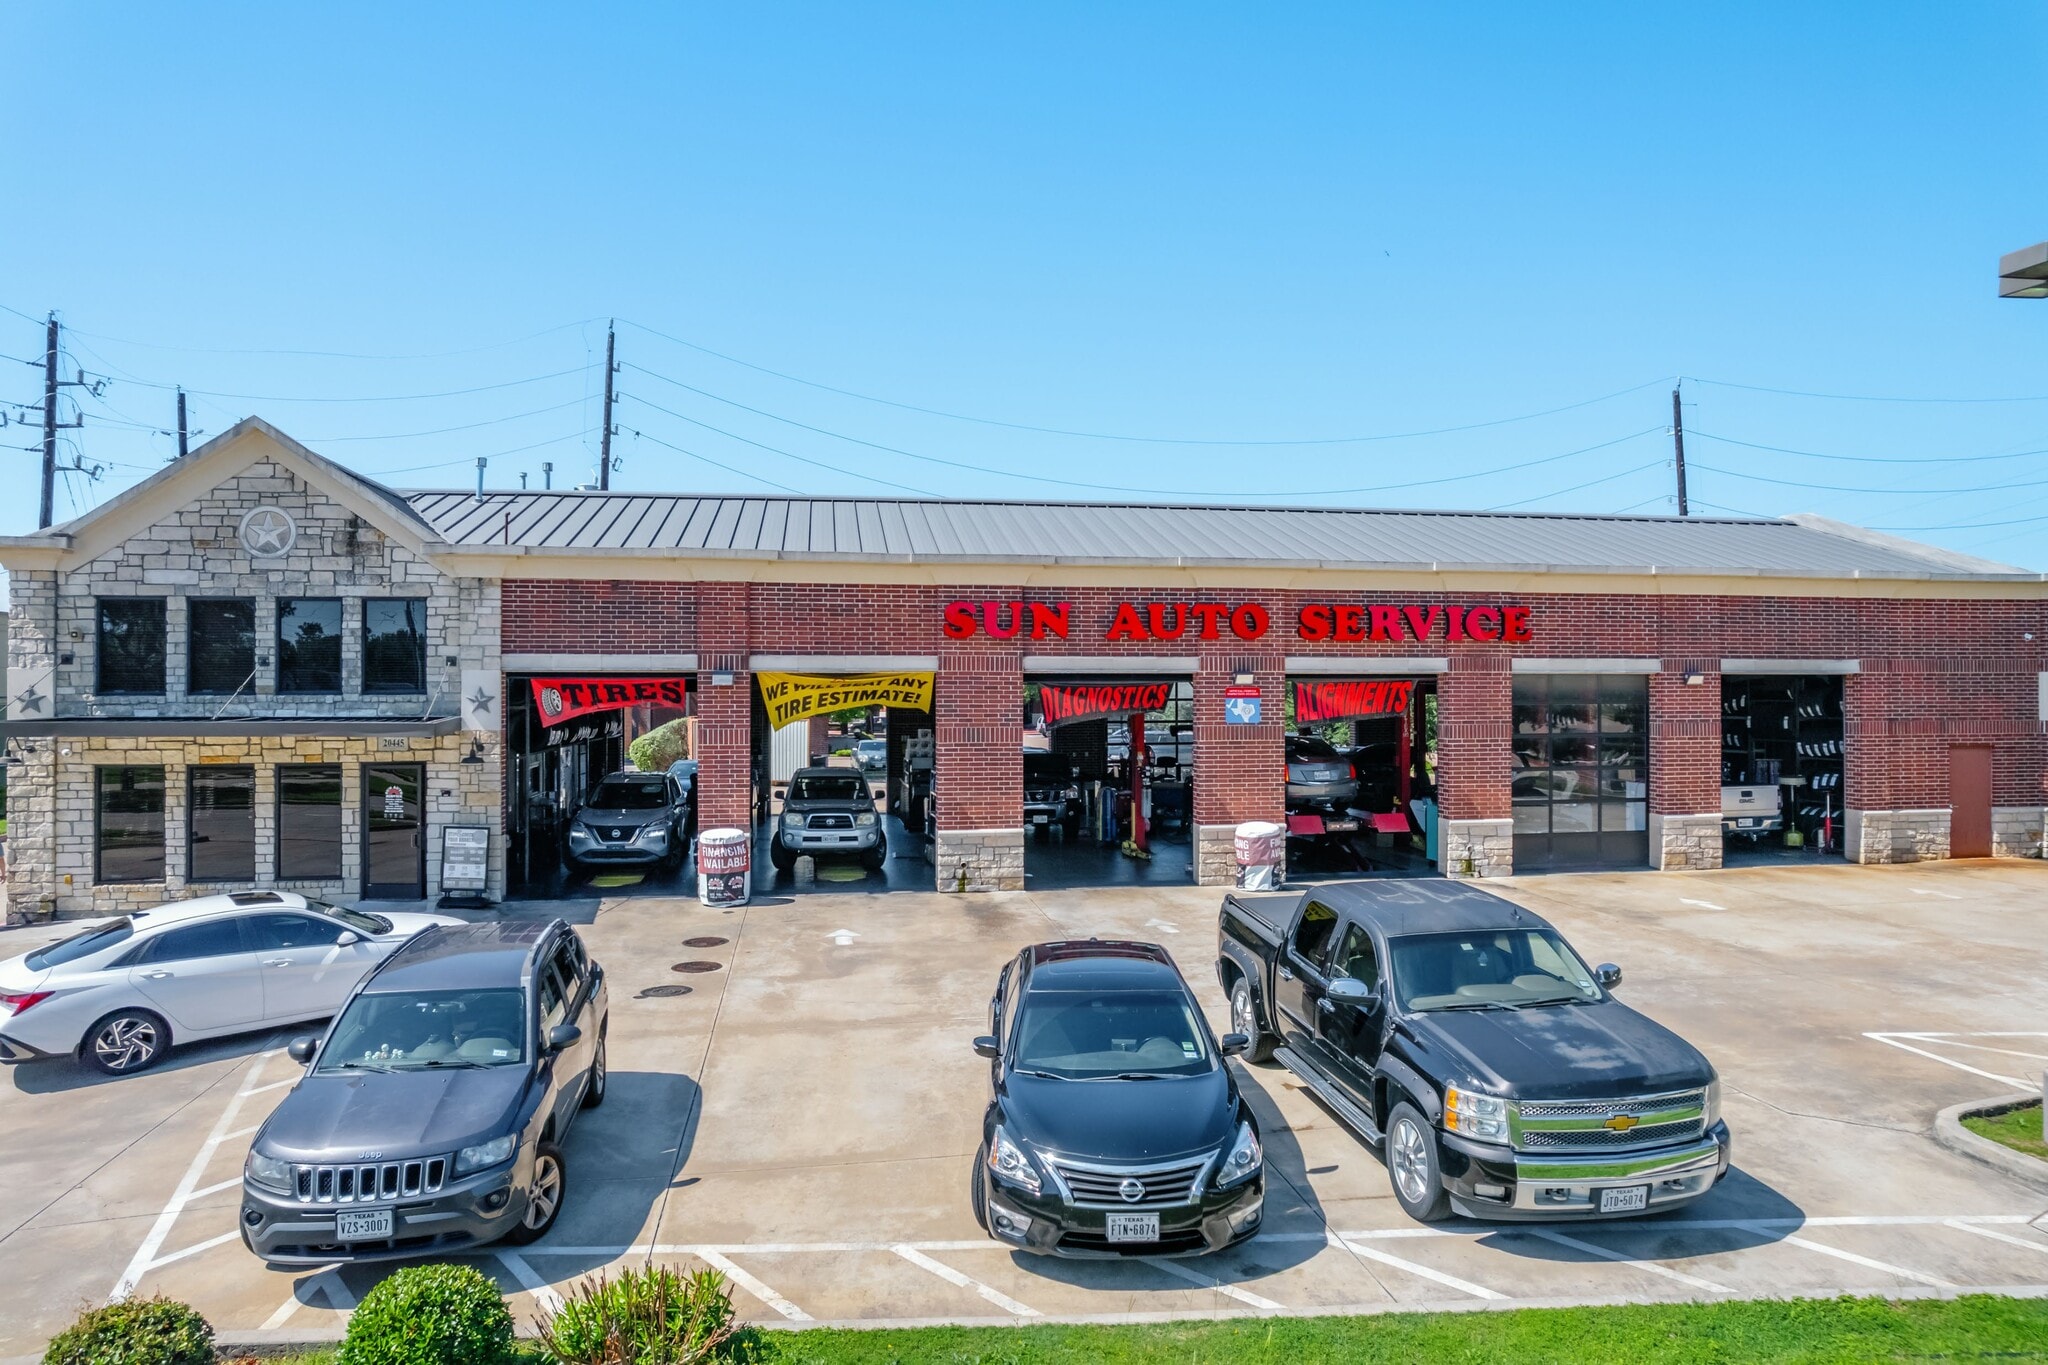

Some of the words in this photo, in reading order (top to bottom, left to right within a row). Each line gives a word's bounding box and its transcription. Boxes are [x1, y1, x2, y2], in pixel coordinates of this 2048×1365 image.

[943, 600, 1071, 640] SUN
[1105, 601, 1270, 641] AUTO
[1298, 604, 1533, 642] SERVICE
[561, 680, 682, 709] TIRES
[766, 682, 789, 702] WE
[794, 683, 835, 691] WILL
[839, 679, 885, 689] BEAT
[888, 677, 928, 690] ANY
[1041, 683, 1168, 724] DIAGNOSTICS
[1297, 681, 1412, 723] ALIGNMENTS
[775, 695, 813, 723] TIRE
[817, 689, 922, 708] ESTIMATE!
[383, 738, 405, 748] 20445
[358, 1151, 382, 1160] Jeep
[354, 1212, 375, 1220] TEXAS
